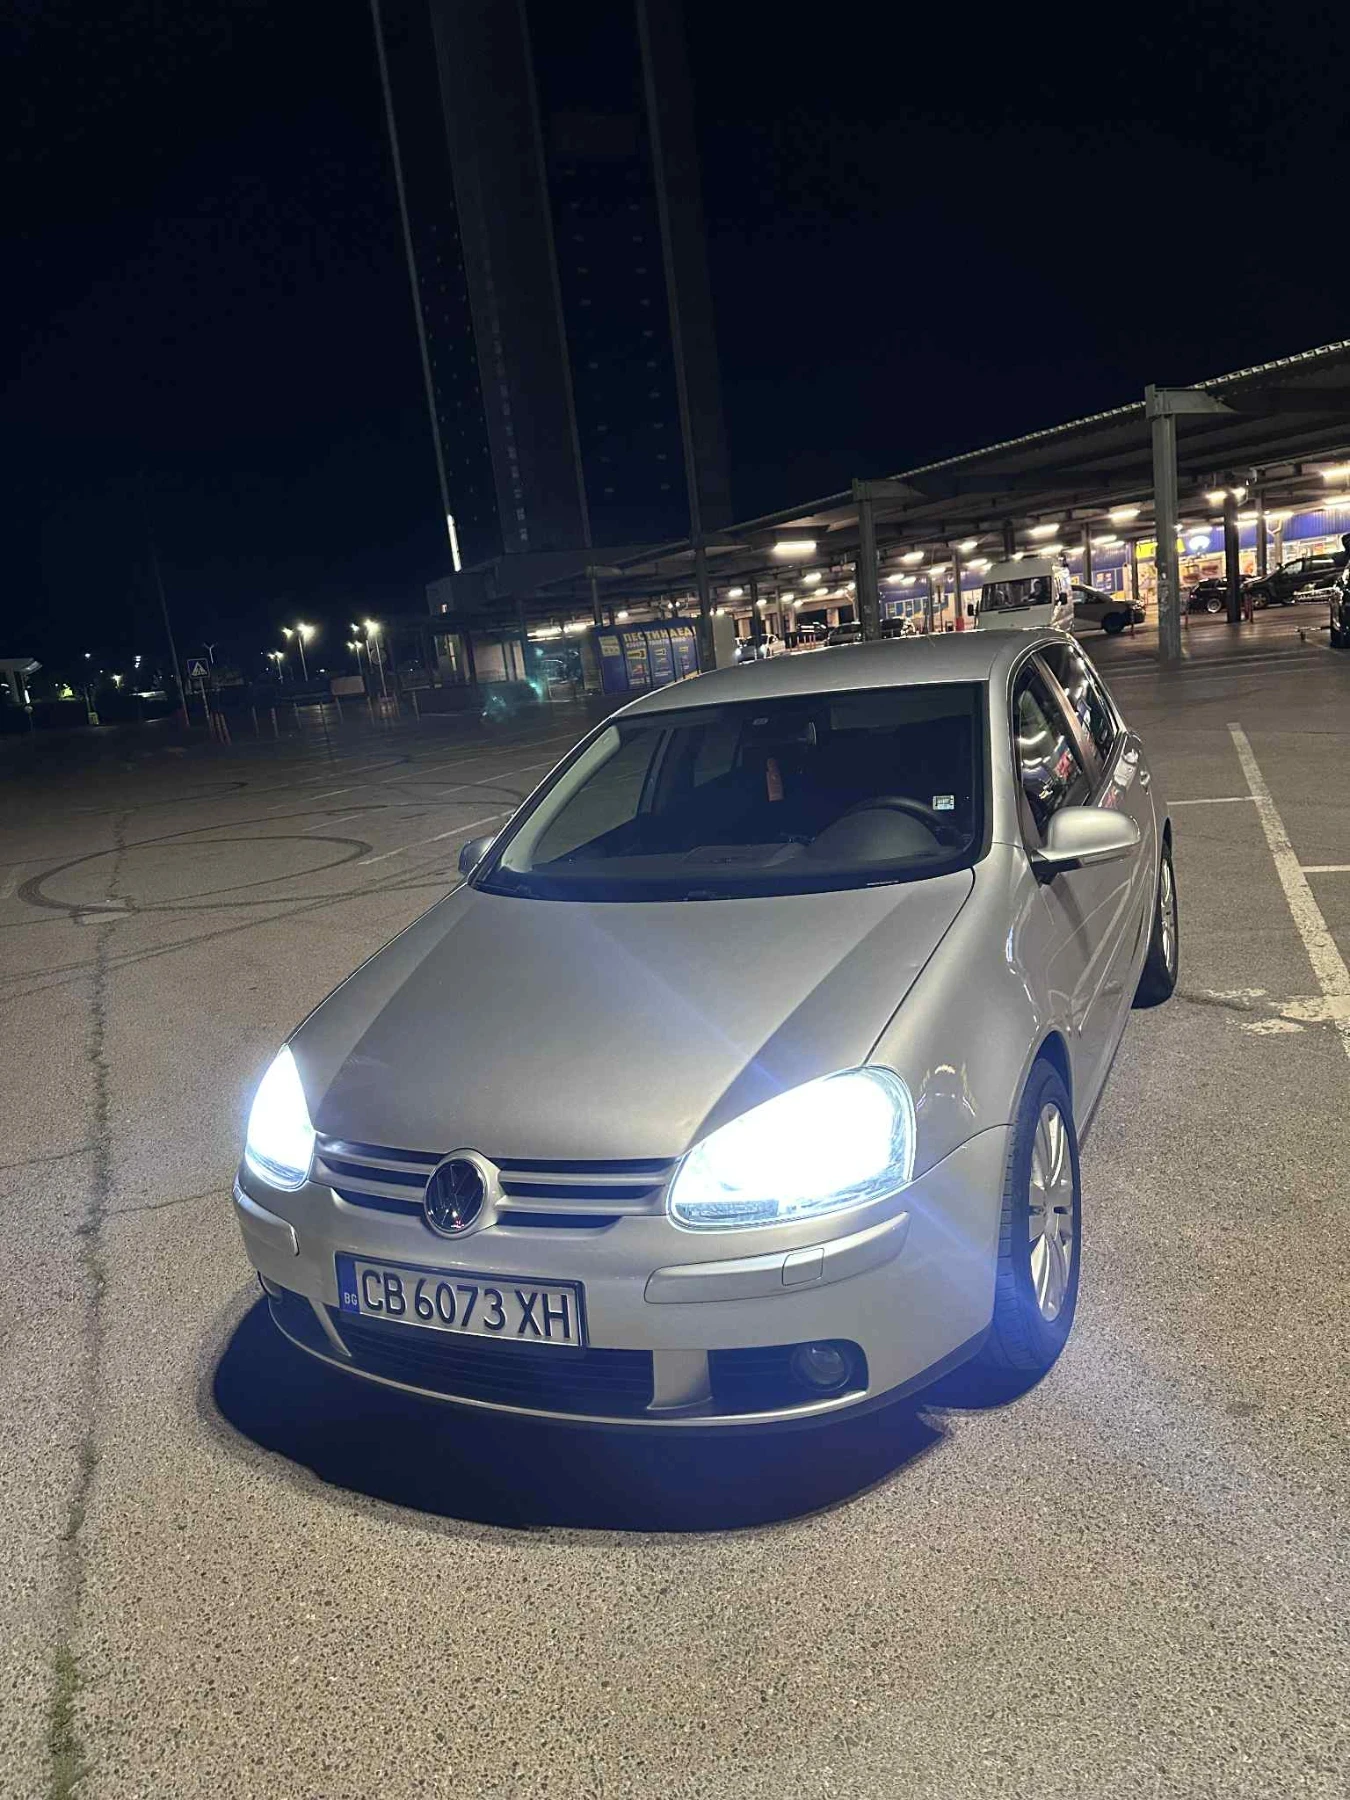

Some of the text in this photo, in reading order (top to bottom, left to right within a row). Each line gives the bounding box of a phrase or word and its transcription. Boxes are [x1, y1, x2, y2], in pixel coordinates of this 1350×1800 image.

[344, 1292, 358, 1306] BG
[362, 1269, 572, 1339] CB 6073 XH
